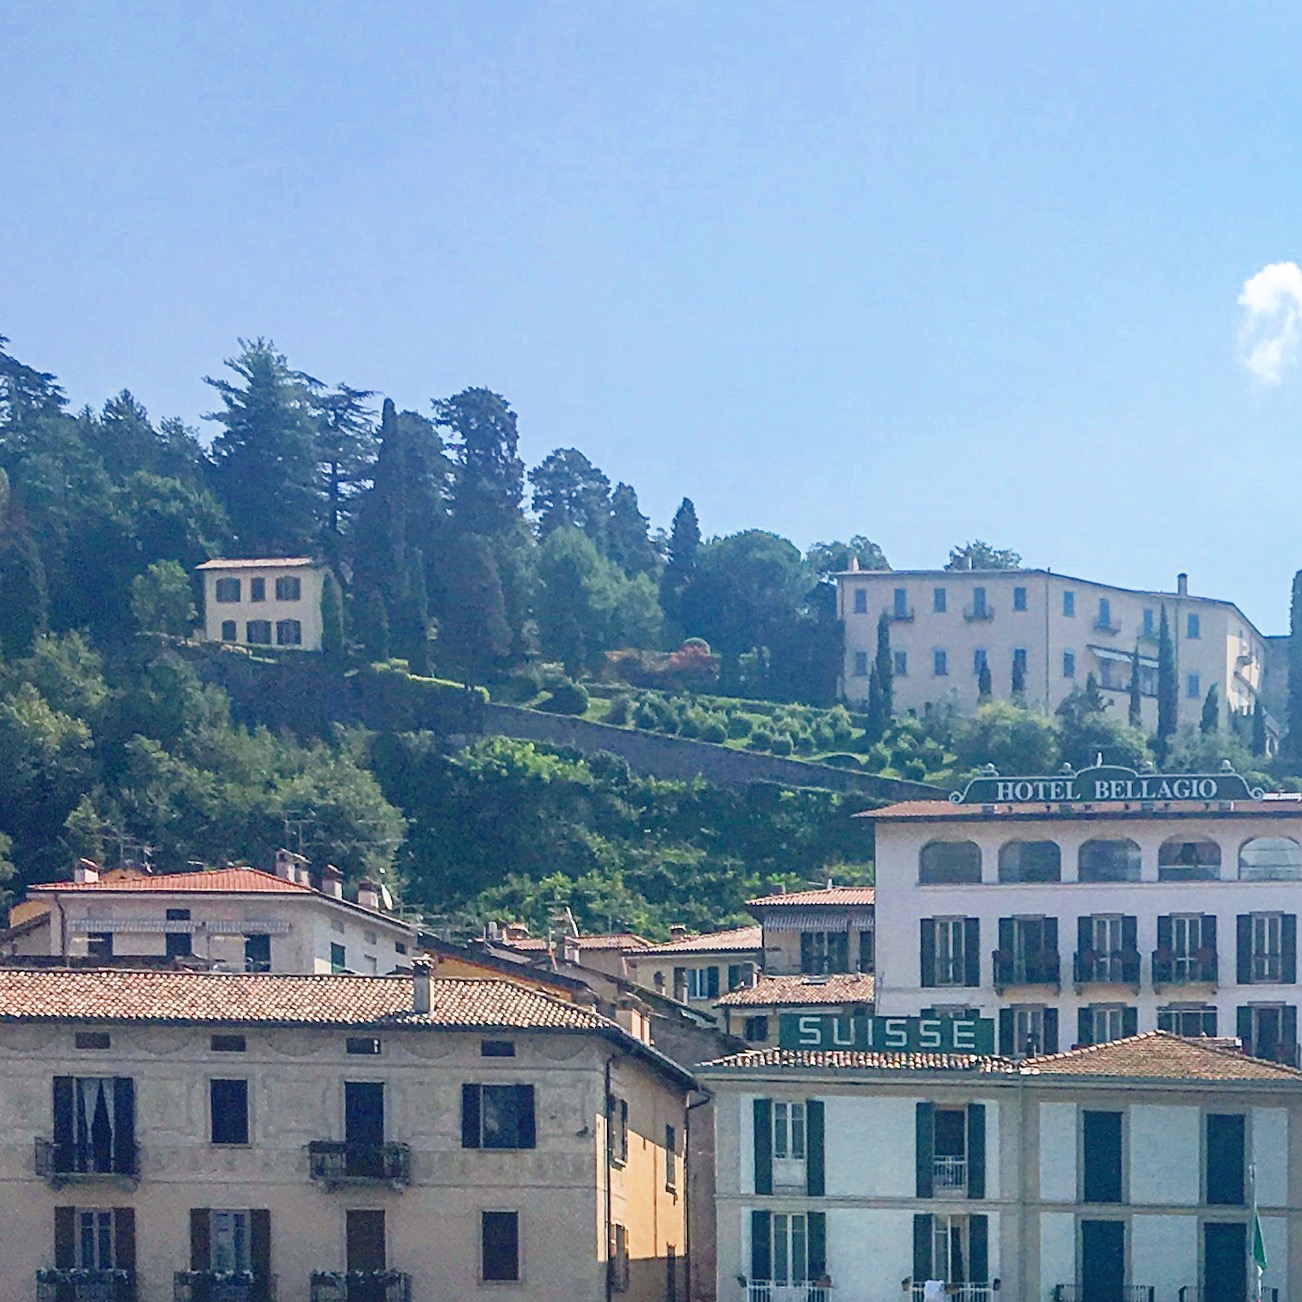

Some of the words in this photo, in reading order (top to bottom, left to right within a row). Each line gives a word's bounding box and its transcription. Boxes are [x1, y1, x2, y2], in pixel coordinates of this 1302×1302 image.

[996, 780, 1082, 801] HOTEL
[1094, 778, 1218, 800] BELLAGIO
[799, 1016, 976, 1049] SUISSE
